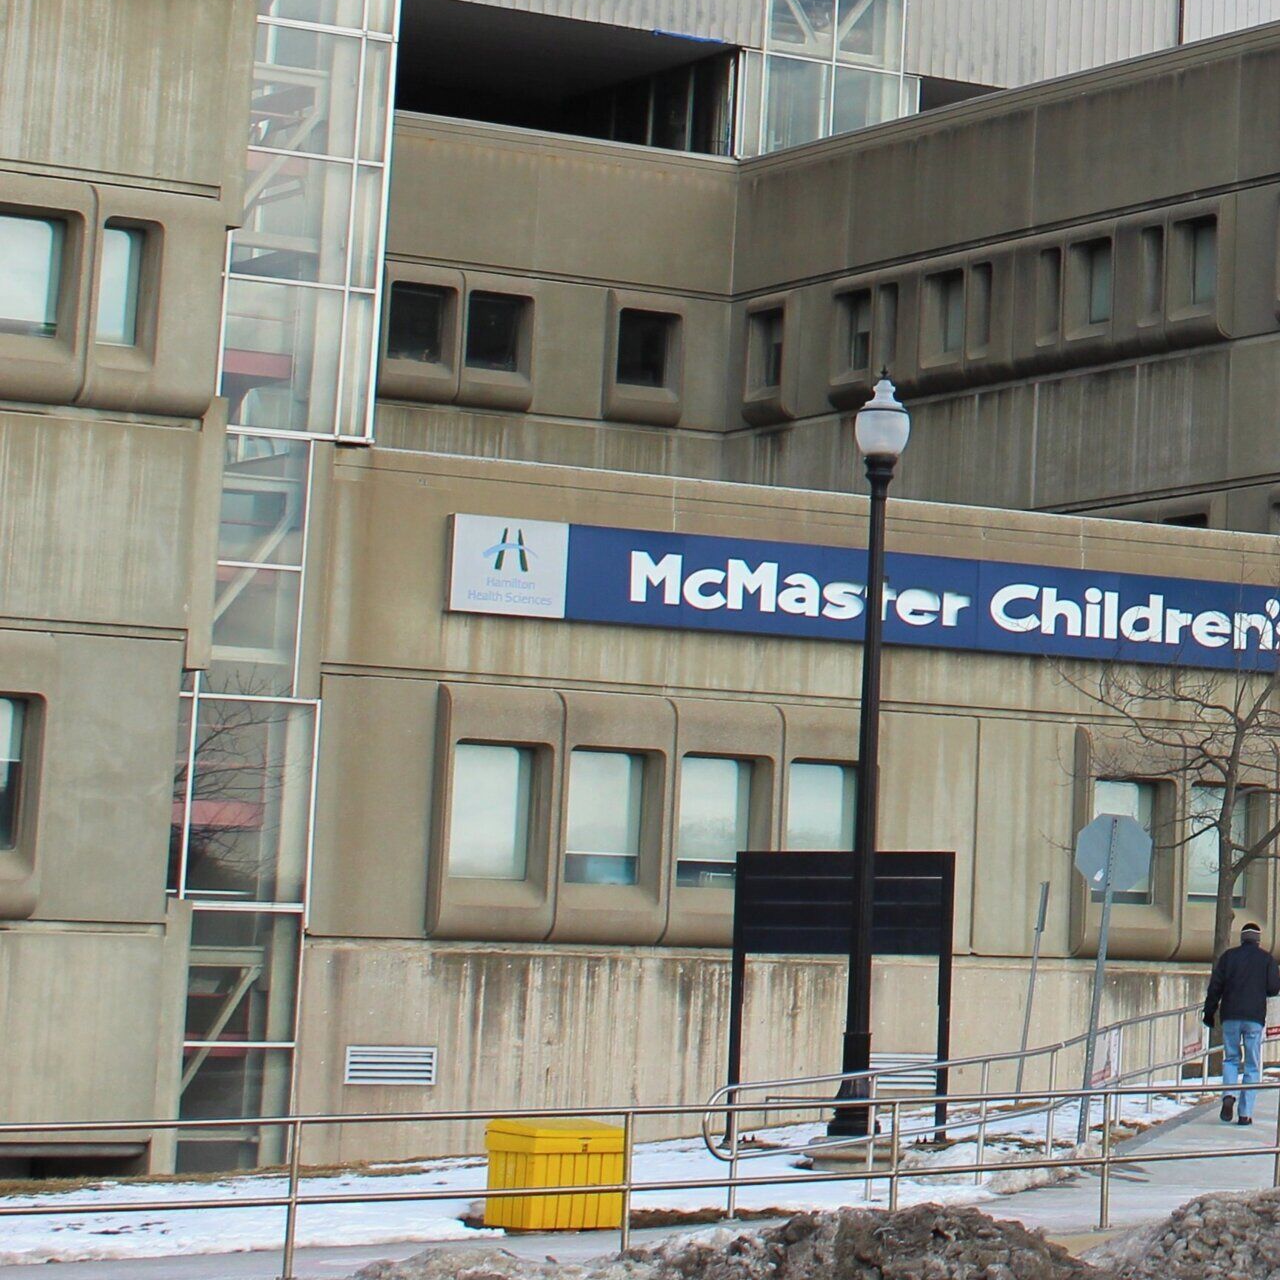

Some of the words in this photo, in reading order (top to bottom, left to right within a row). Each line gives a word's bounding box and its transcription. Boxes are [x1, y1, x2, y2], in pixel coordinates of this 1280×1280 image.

[486, 576, 536, 590] Hamilton
[467, 589, 502, 602] Health
[505, 591, 553, 607] Sciences
